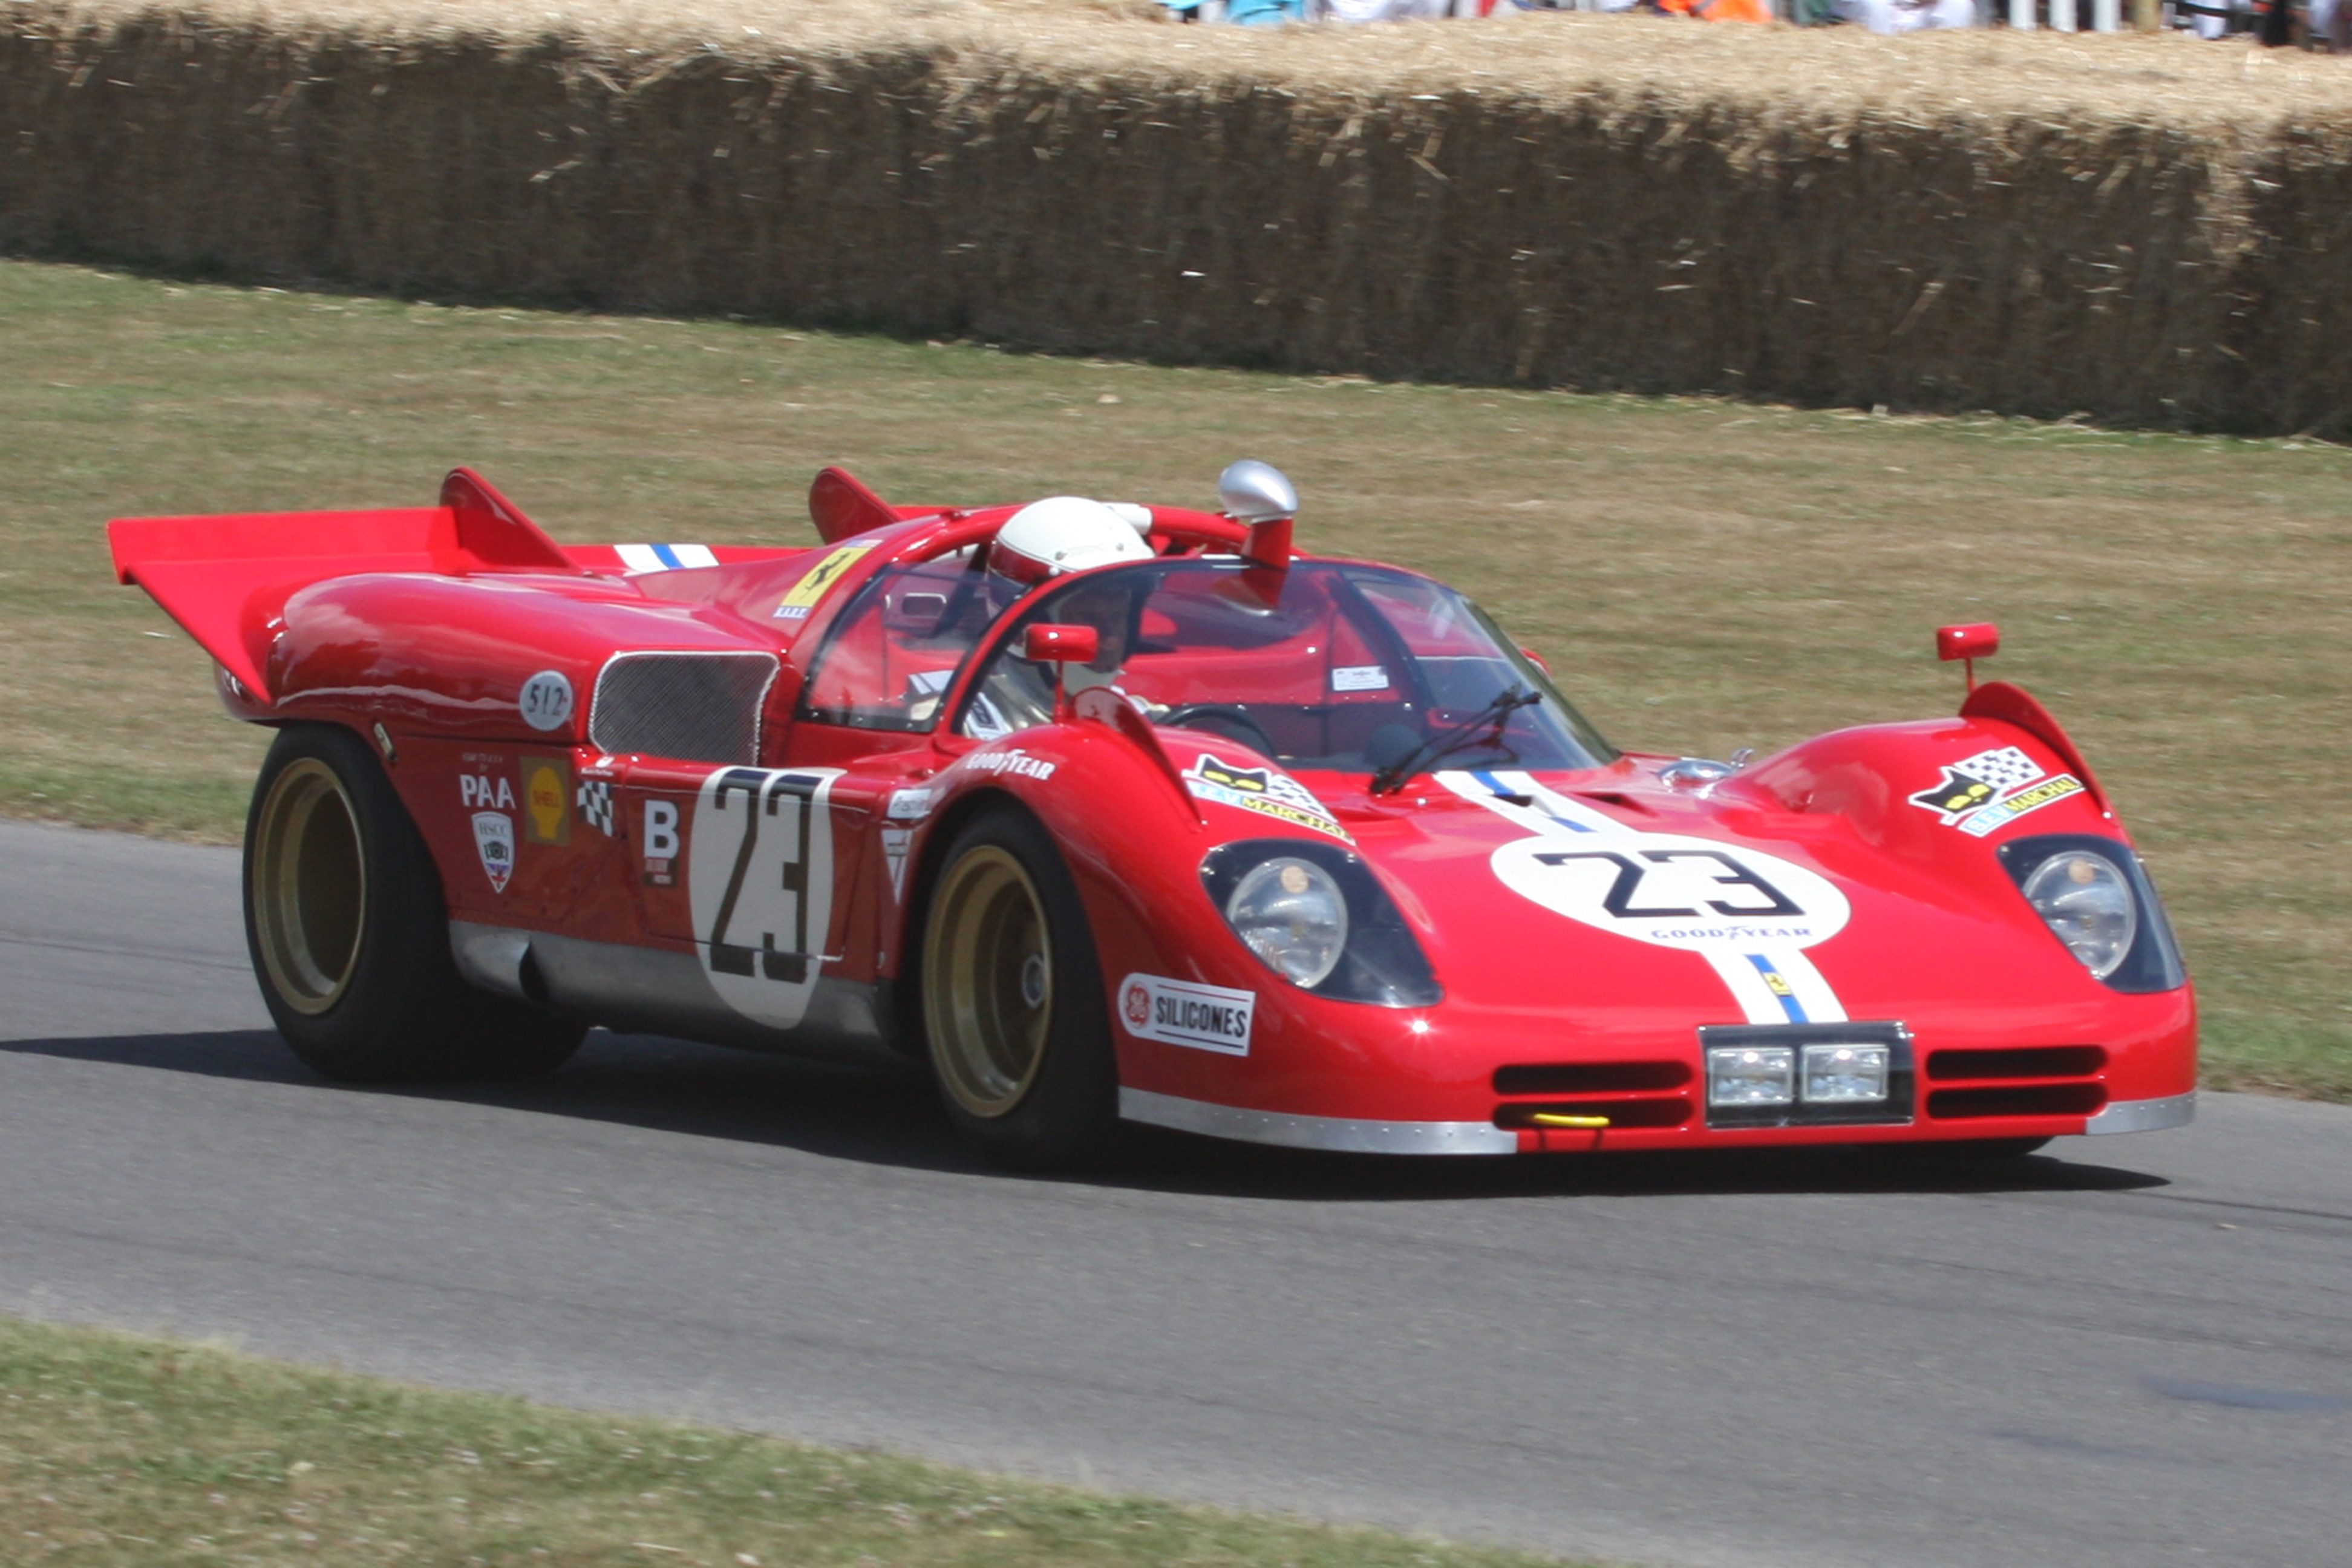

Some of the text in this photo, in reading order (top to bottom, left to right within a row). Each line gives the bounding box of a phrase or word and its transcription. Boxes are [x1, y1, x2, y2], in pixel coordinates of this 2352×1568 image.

[460, 774, 517, 810] PAA
[644, 799, 679, 860] B
[711, 770, 824, 984] 23
[1532, 849, 1806, 918] 23
[1156, 996, 1248, 1037] SILICONES
